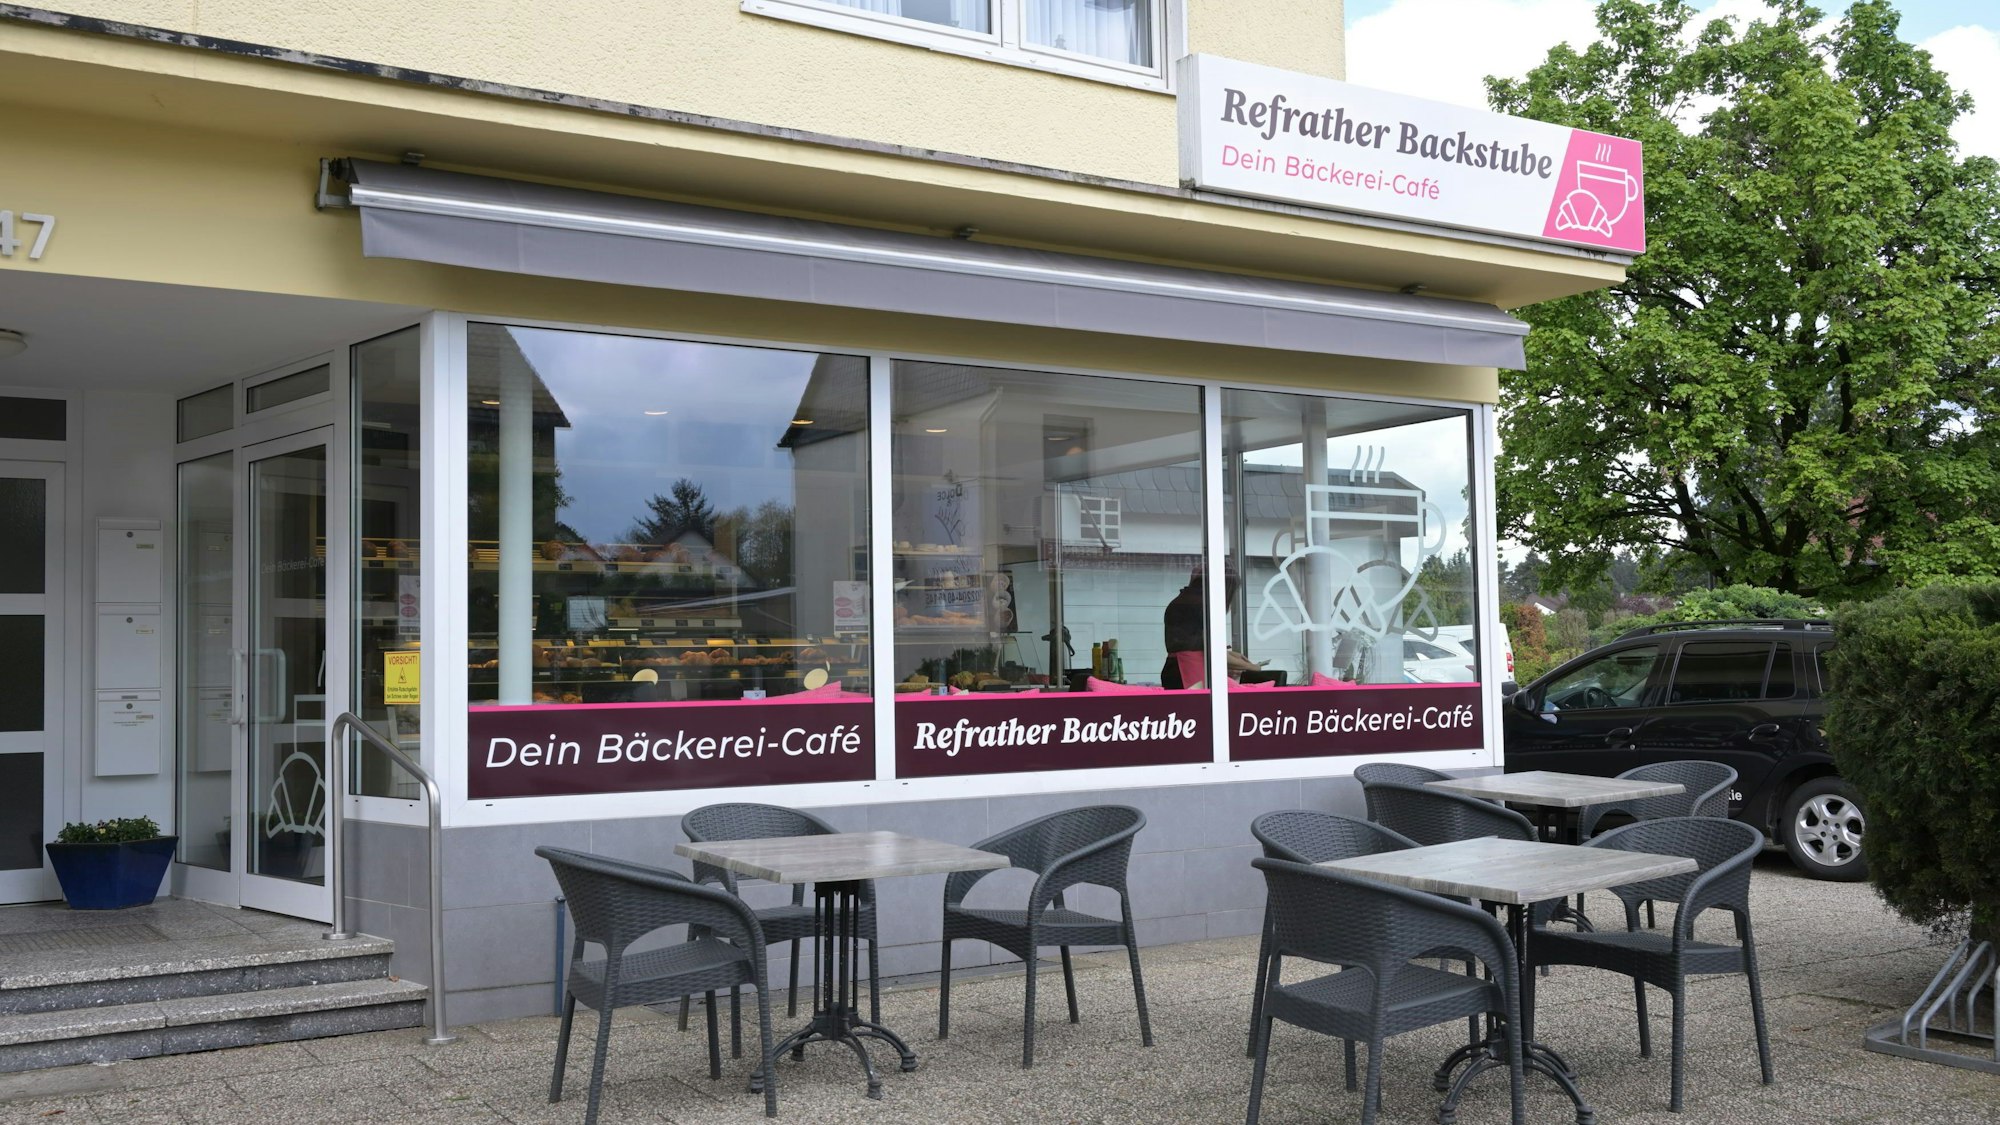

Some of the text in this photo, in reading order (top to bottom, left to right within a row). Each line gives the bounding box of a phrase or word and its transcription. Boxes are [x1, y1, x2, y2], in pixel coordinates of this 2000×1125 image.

[1220, 87, 1553, 180] Refrather Backstube
[1221, 145, 1441, 200] Dein Bäckerei-Café
[388, 655, 418, 665] VORSICHT!
[913, 712, 1197, 757] Refrather Backstube
[1238, 704, 1474, 737] Dein Bäckerei-Café
[485, 724, 861, 768] Dein Bäckerei-Café
